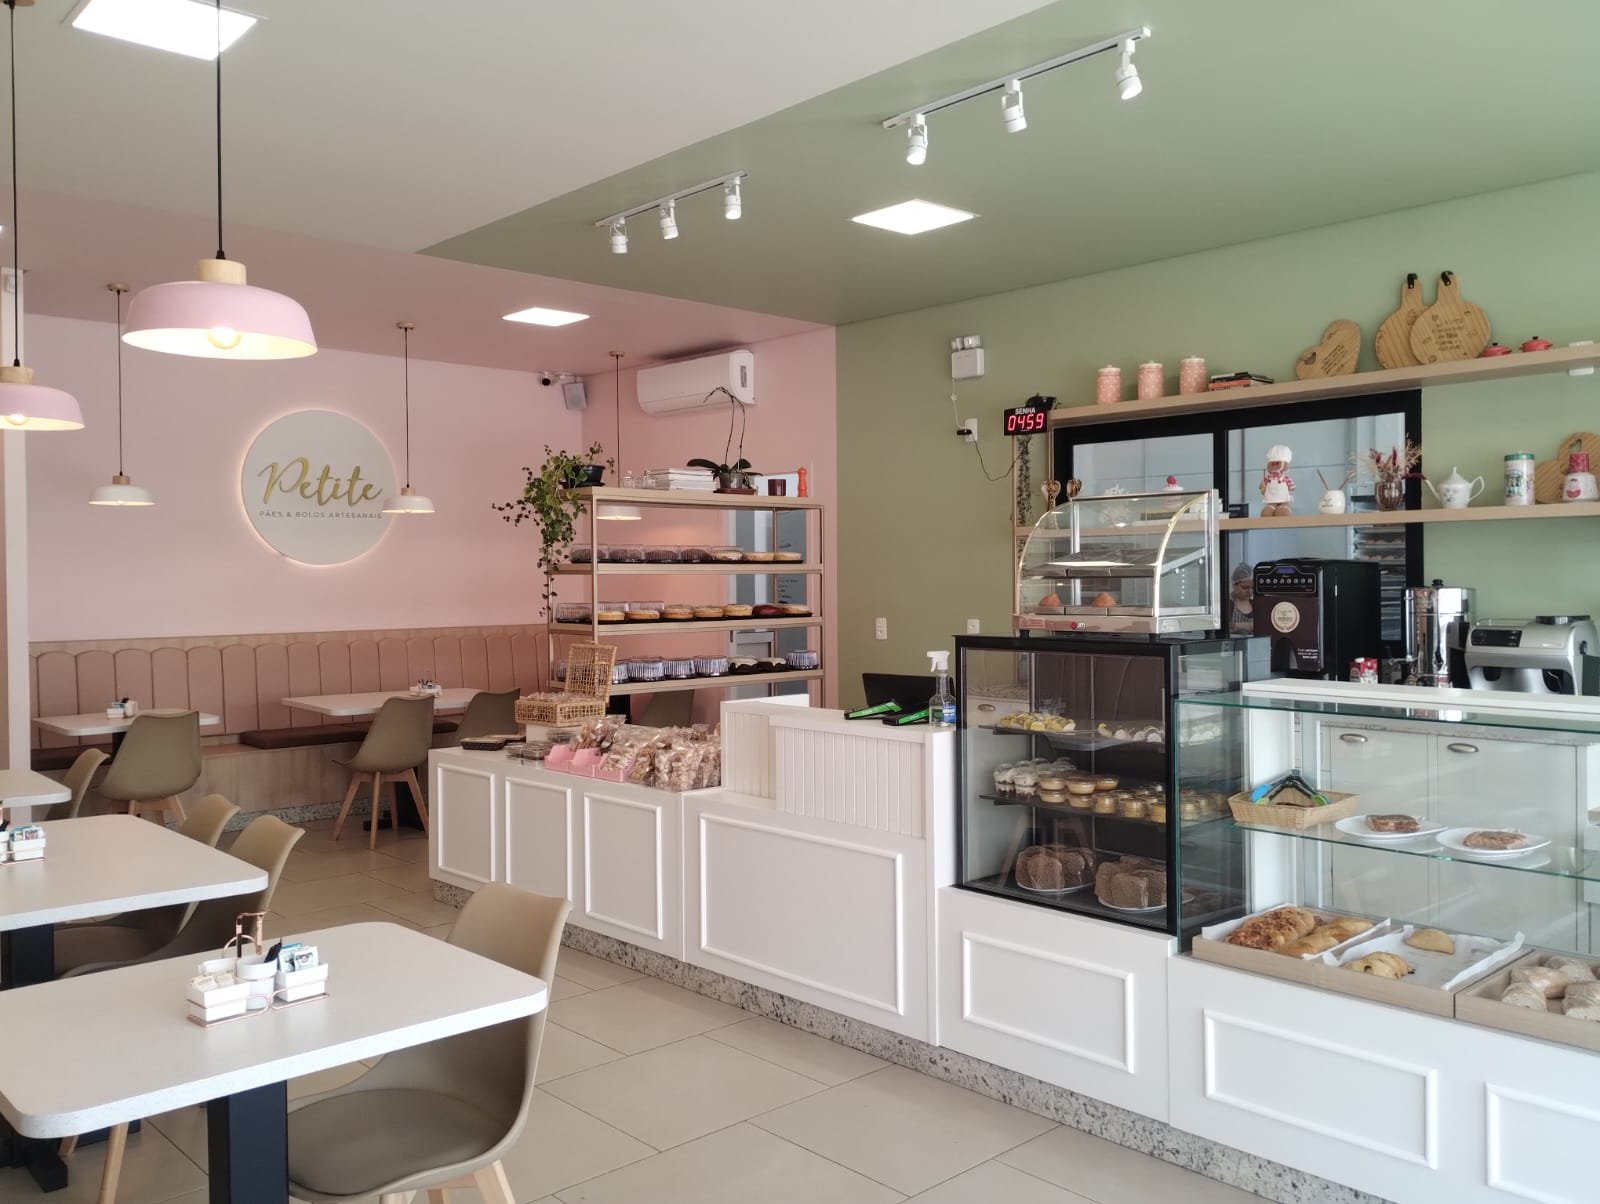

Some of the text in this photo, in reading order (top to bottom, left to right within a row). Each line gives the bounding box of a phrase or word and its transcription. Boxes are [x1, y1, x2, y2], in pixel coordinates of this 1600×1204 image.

[1015, 407, 1036, 415] SENHA
[1007, 413, 1044, 431] 0459
[257, 456, 384, 507] Petite
[328, 511, 382, 519] ARTESANAIS
